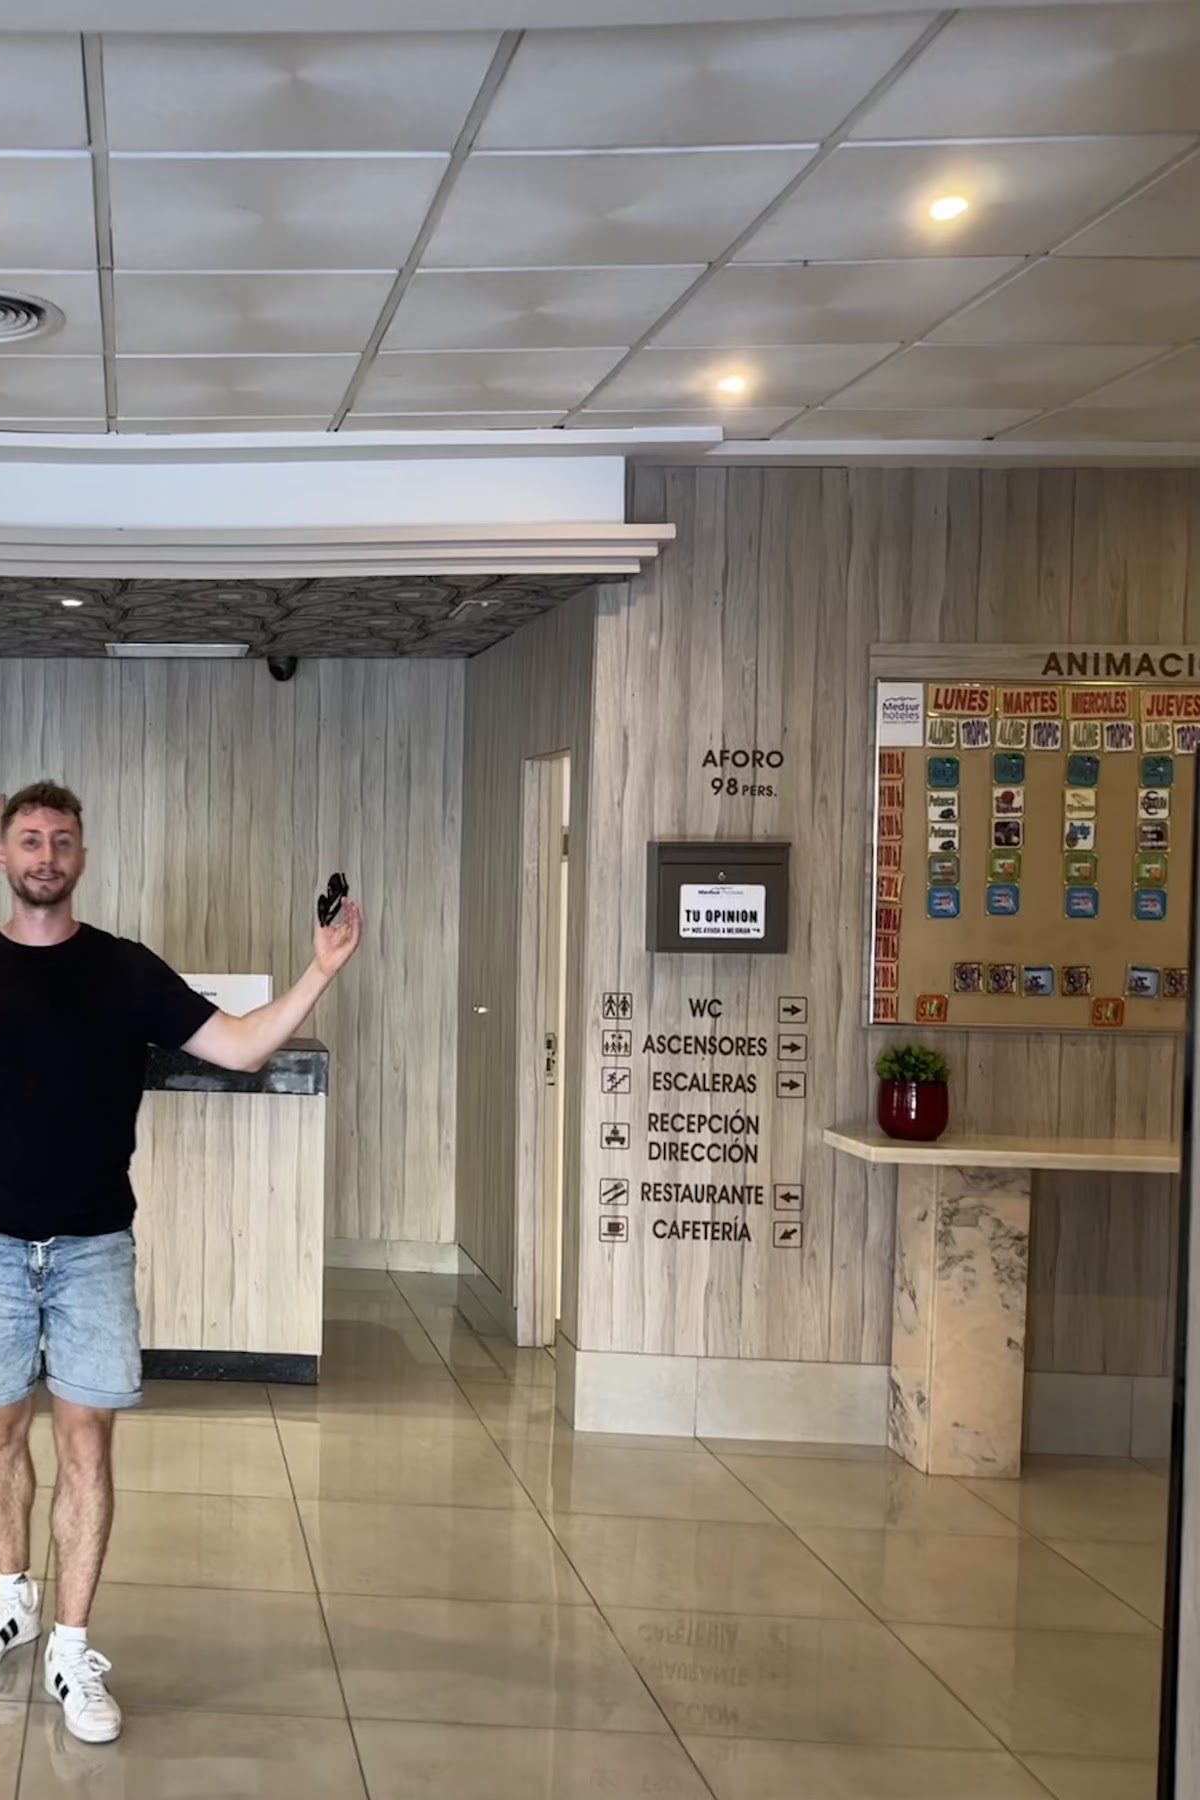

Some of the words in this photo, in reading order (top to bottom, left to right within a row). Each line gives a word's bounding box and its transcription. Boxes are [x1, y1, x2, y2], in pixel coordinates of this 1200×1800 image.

[1041, 652, 1200, 677] ANIMACI
[882, 702, 919, 711] Medsur
[933, 688, 989, 711] LUNES
[1003, 691, 1058, 714] MARTES
[1071, 691, 1126, 714] MIERCOLES
[1146, 694, 1200, 717] JUEVES
[882, 711, 920, 719] hoteles
[702, 750, 784, 768] AFORO
[711, 778, 738, 795] 98
[742, 785, 777, 797] PERS.
[685, 909, 700, 923] TU
[689, 998, 723, 1018] WC
[642, 1034, 767, 1056] ASCENSORES
[652, 1072, 757, 1093] ESCALERAS
[648, 1108, 759, 1135] RECEPCIÓN
[648, 1138, 758, 1163] DIRECCIÓN
[641, 1182, 763, 1205] RESTAURANTE
[652, 1216, 751, 1241] CAFETERÍA
